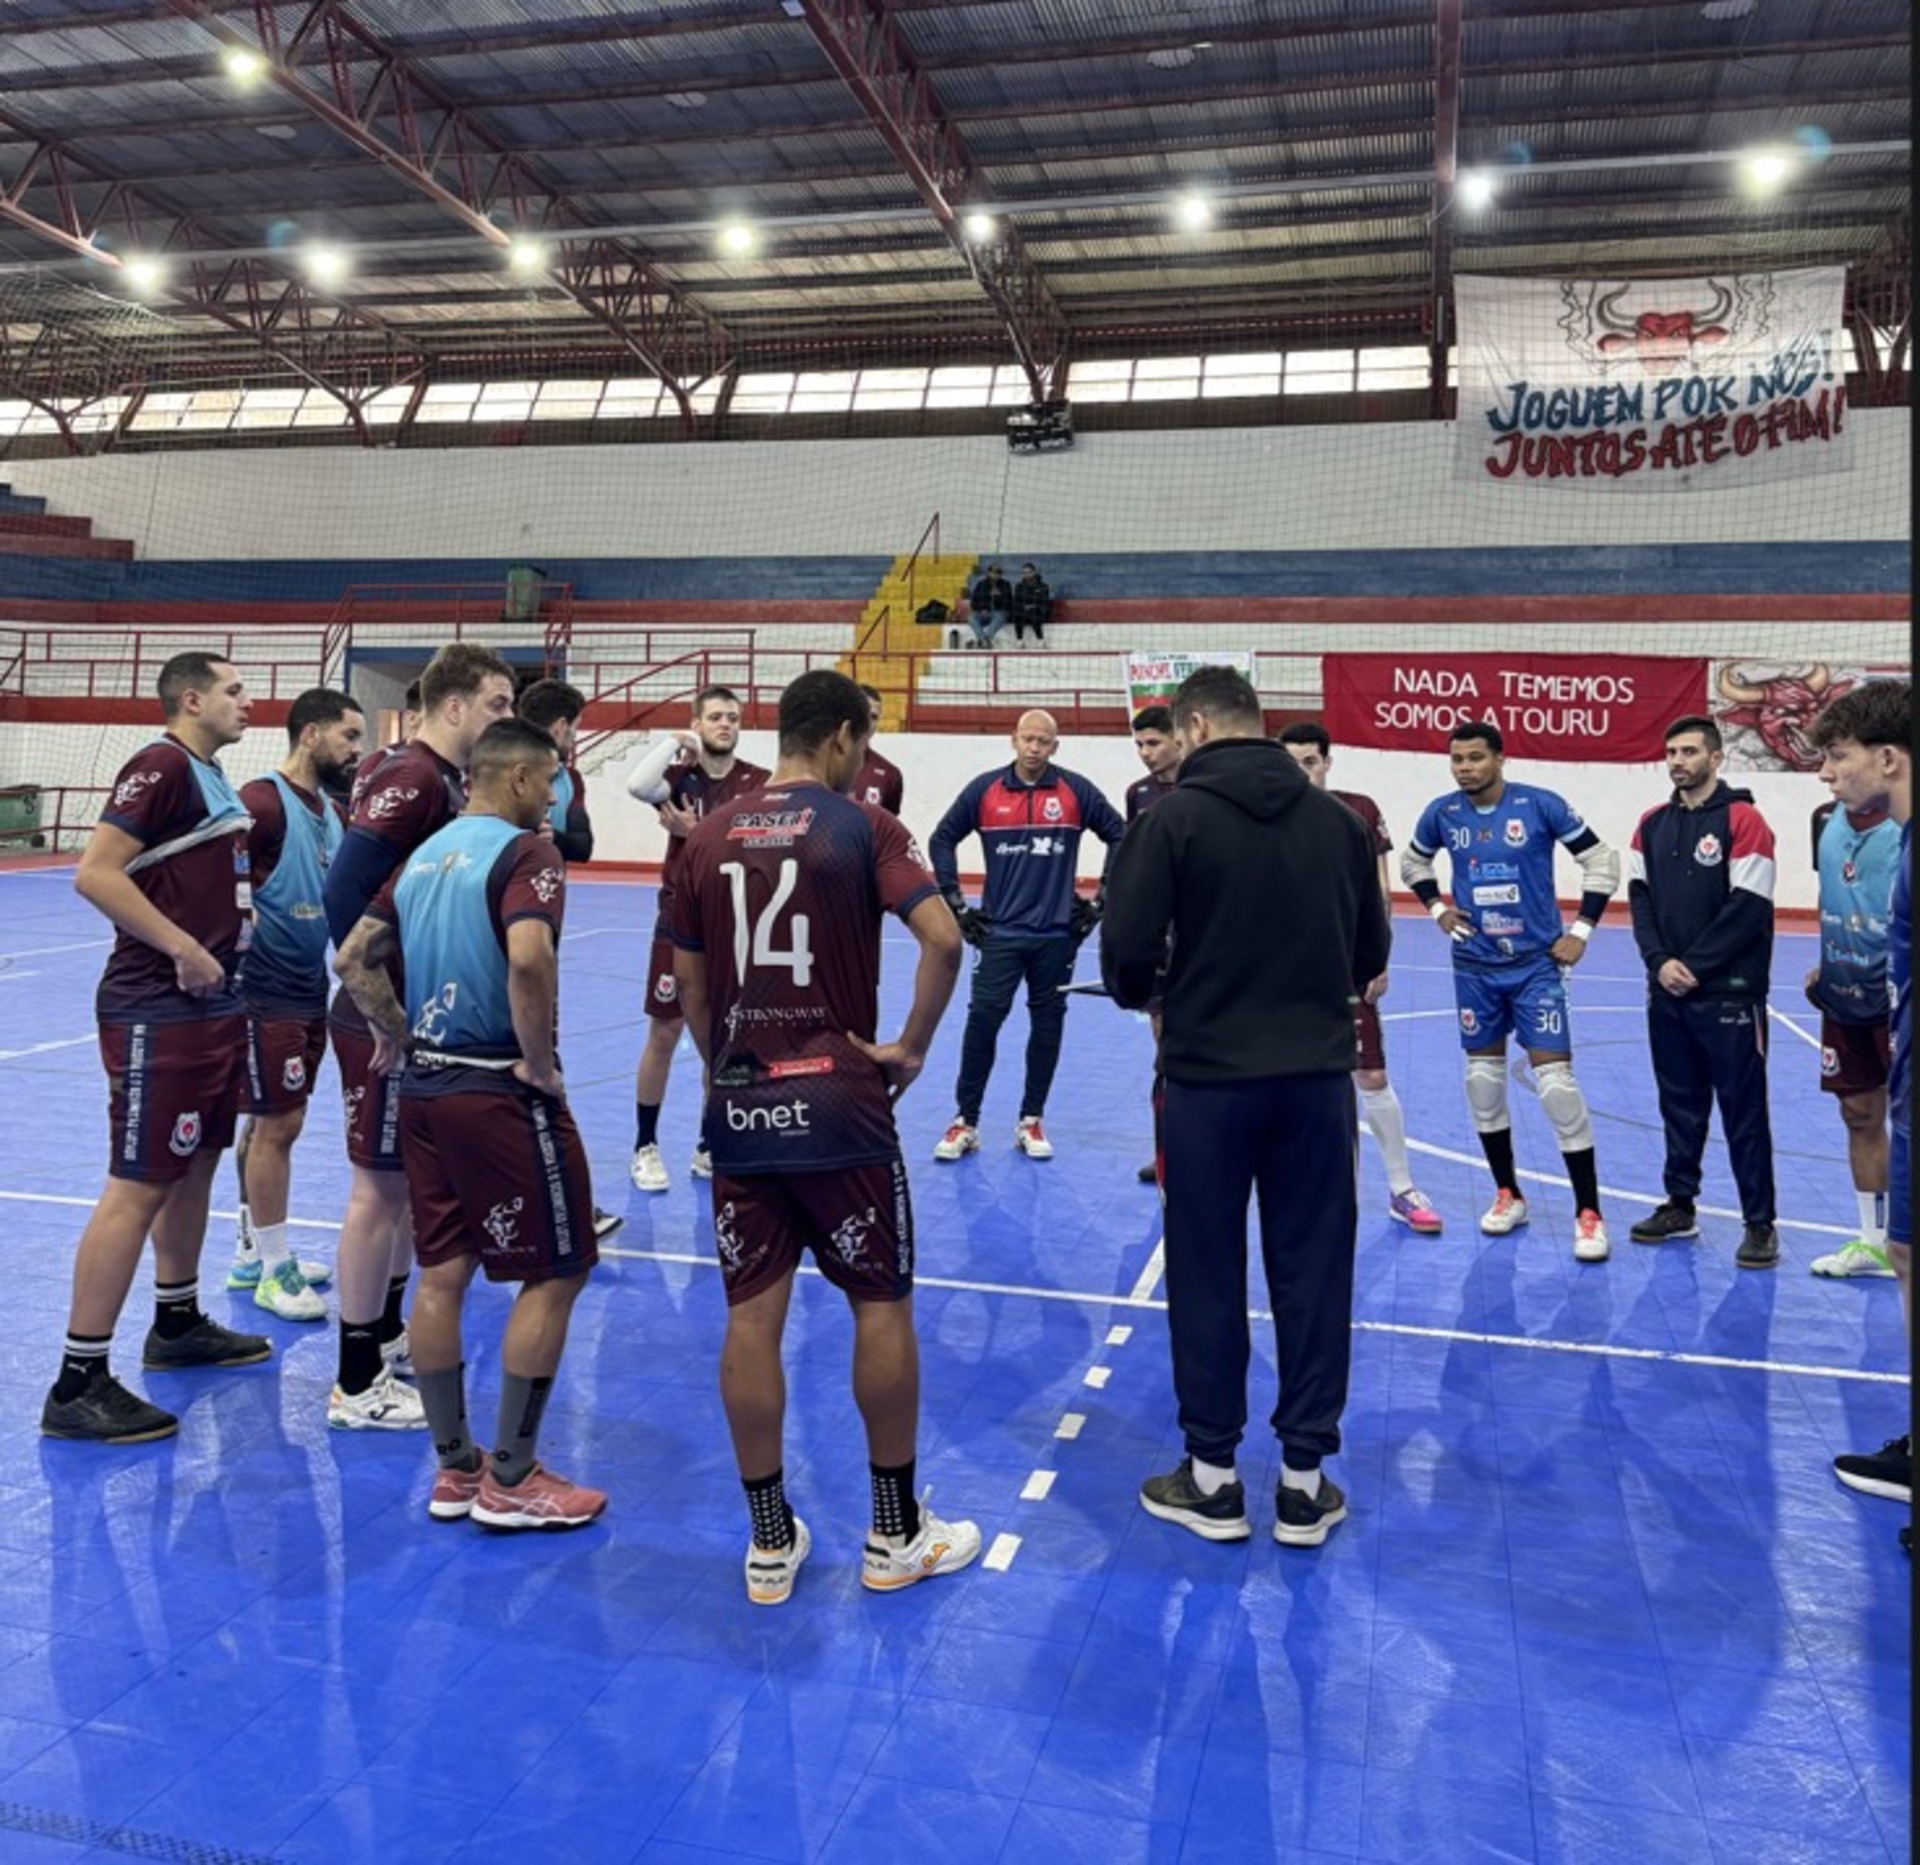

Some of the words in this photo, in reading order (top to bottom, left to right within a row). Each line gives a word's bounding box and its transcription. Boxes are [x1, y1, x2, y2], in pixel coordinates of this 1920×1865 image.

[1486, 381, 1644, 431] JOGUEM
[1485, 428, 1648, 478] JUNTOS
[1393, 667, 1479, 698] NADA
[1497, 670, 1635, 703] TEMEMOS
[1374, 701, 1472, 732] SOMOS
[1448, 826, 1470, 851] 30
[719, 858, 815, 987] 14
[1535, 1009, 1561, 1034] 30
[726, 1099, 810, 1131] bnet
